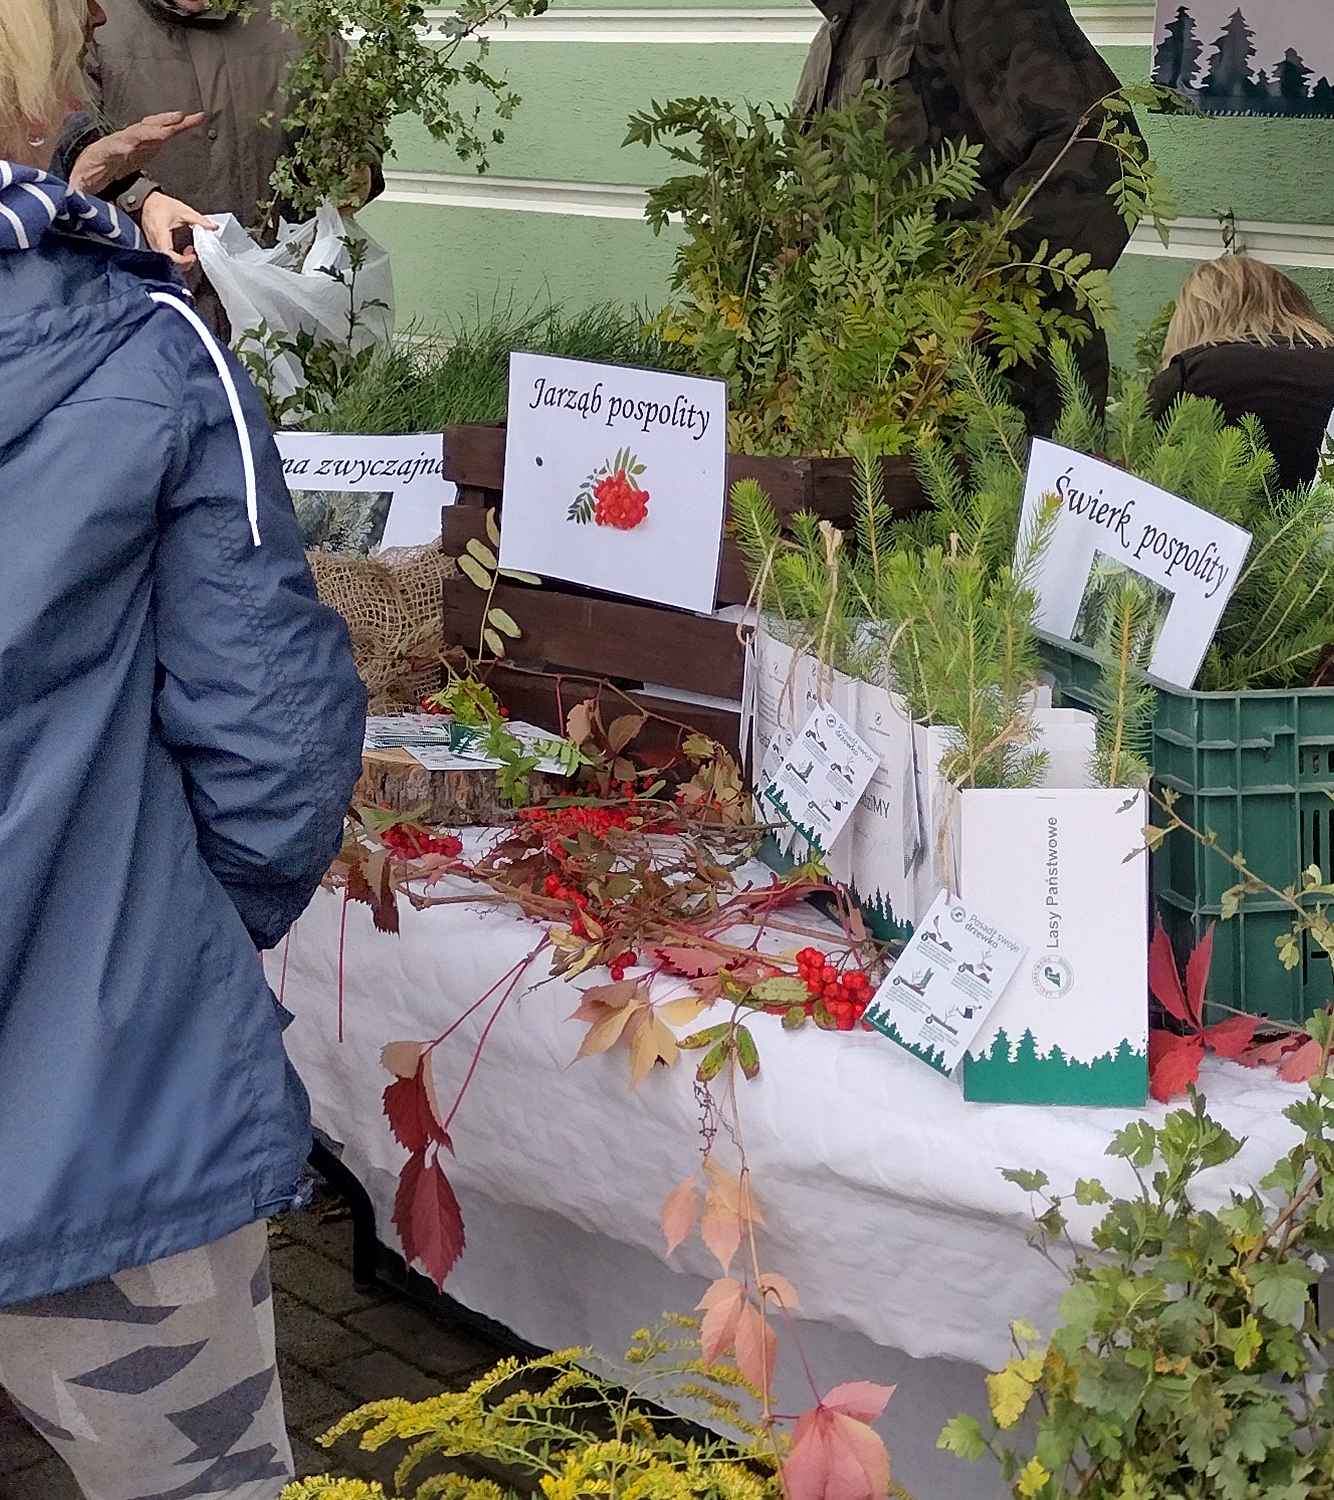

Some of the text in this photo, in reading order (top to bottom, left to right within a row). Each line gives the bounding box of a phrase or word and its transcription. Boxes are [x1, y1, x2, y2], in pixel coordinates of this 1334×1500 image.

[529, 377, 711, 441] Jarząb pospolity
[1055, 466, 1230, 599] Świerk pospolity
[1045, 816, 1062, 948] Lasy Państwowe
[964, 923, 999, 950] drzewko
